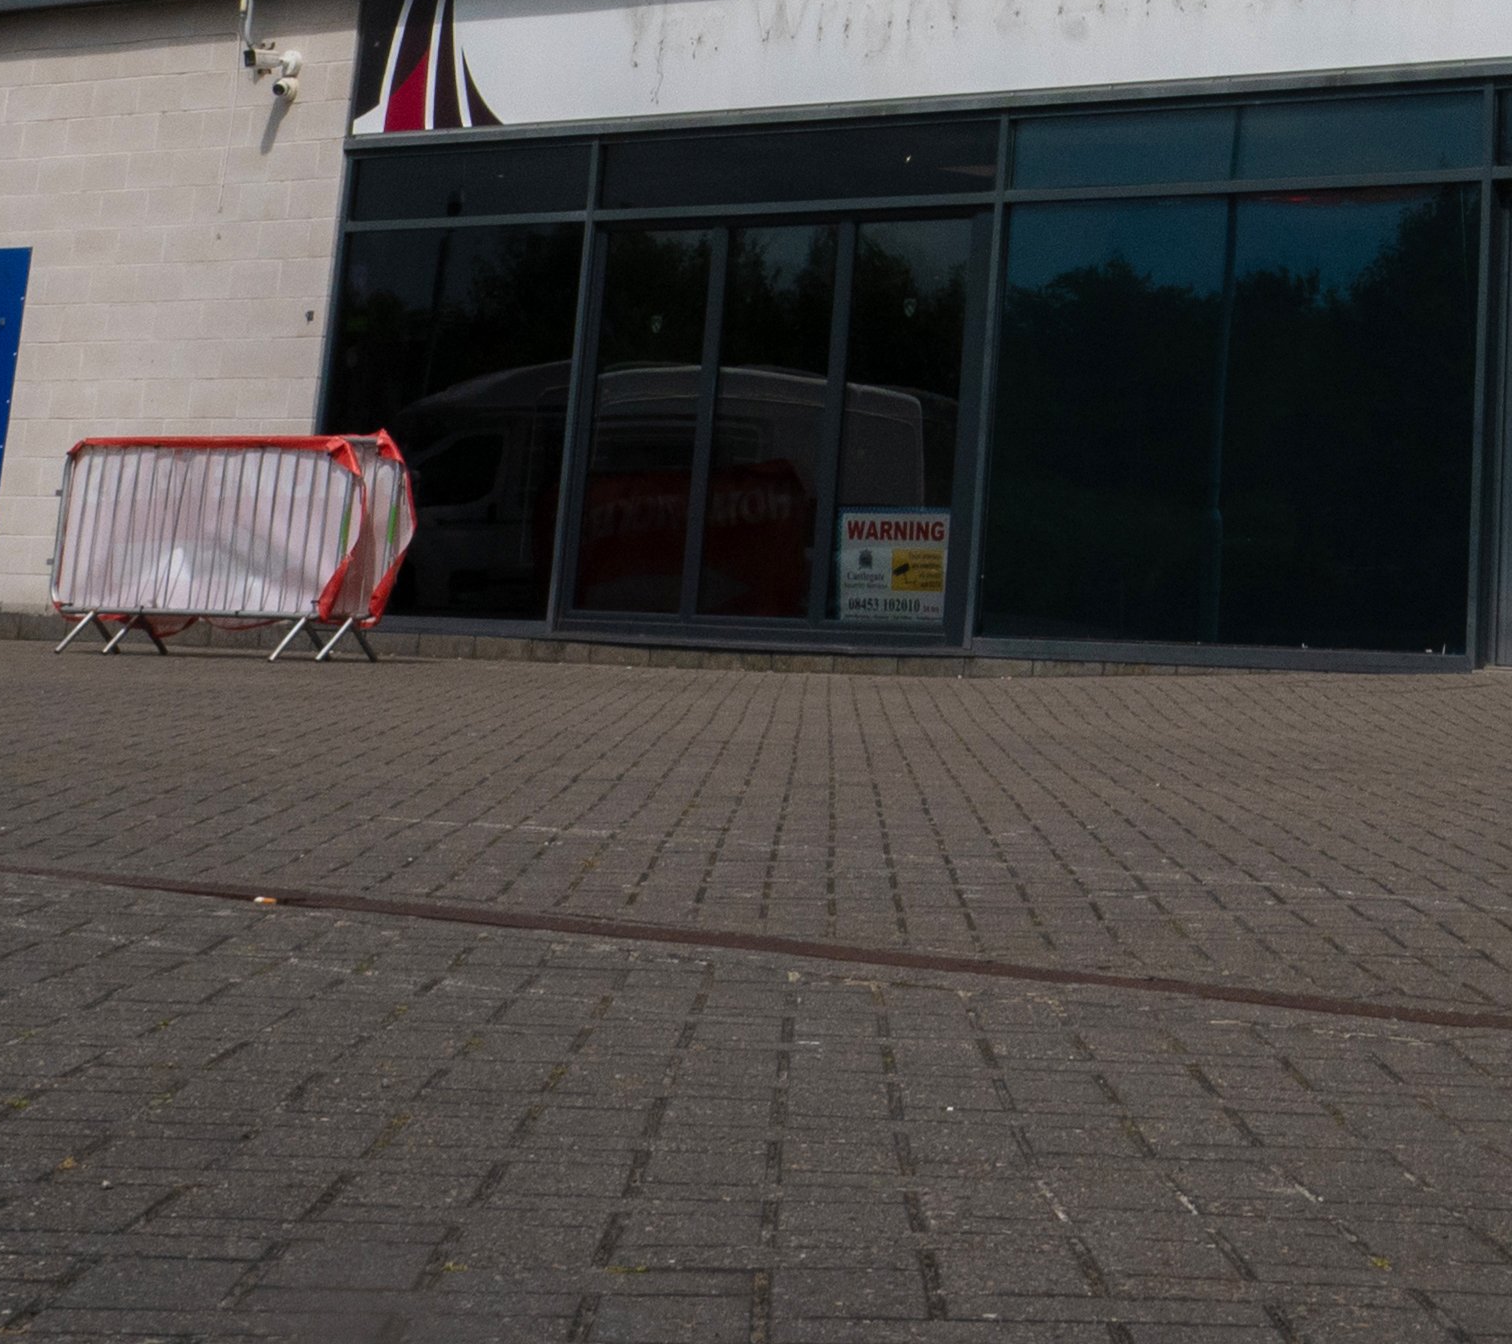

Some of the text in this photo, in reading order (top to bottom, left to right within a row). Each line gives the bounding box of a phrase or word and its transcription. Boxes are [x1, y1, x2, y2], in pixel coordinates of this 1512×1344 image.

[847, 519, 945, 542] WARNING
[849, 598, 880, 611] 08453
[883, 598, 921, 612] 102010
